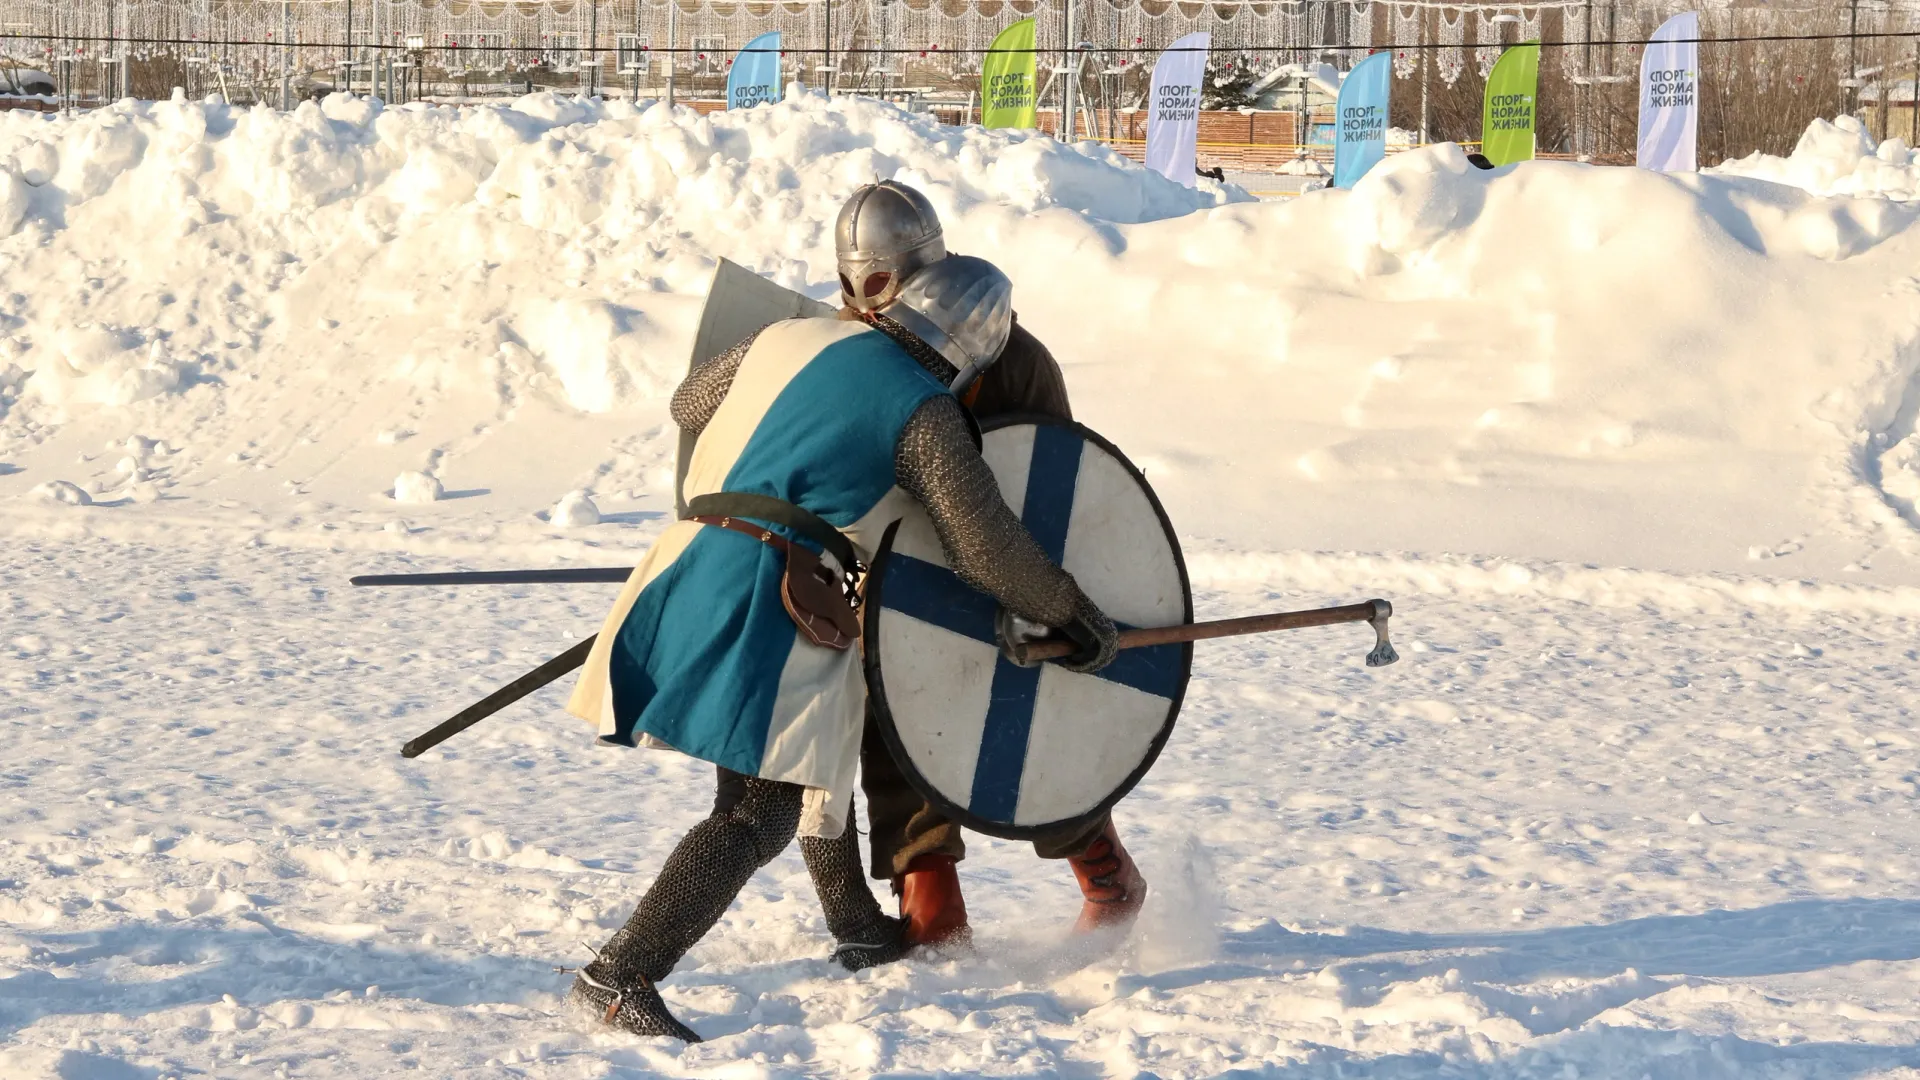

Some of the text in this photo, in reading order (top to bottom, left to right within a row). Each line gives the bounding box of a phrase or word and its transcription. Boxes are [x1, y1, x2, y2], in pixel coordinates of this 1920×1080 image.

[990, 72, 1024, 86] СПОРТ
[1650, 69, 1685, 82] СПОРТ
[735, 84, 769, 97] СПОРТ
[991, 84, 1032, 98] НОРМА
[1159, 85, 1192, 96] СПОРТ
[1650, 81, 1693, 95] НОРМА
[991, 96, 1031, 110] ЖИЗНИ
[1158, 97, 1196, 109] НОРМА
[1491, 94, 1524, 106] СПОРТ
[1650, 94, 1693, 108] ЖИЗНИ
[1158, 109, 1195, 121] ЖИЗНИ
[1343, 105, 1375, 118] СПОРТ
[1491, 105, 1531, 118] НОРМА
[1343, 117, 1382, 130] НОРМА
[1491, 117, 1530, 130] ЖИЗНИ
[1343, 129, 1381, 142] ЖИЗНИ
